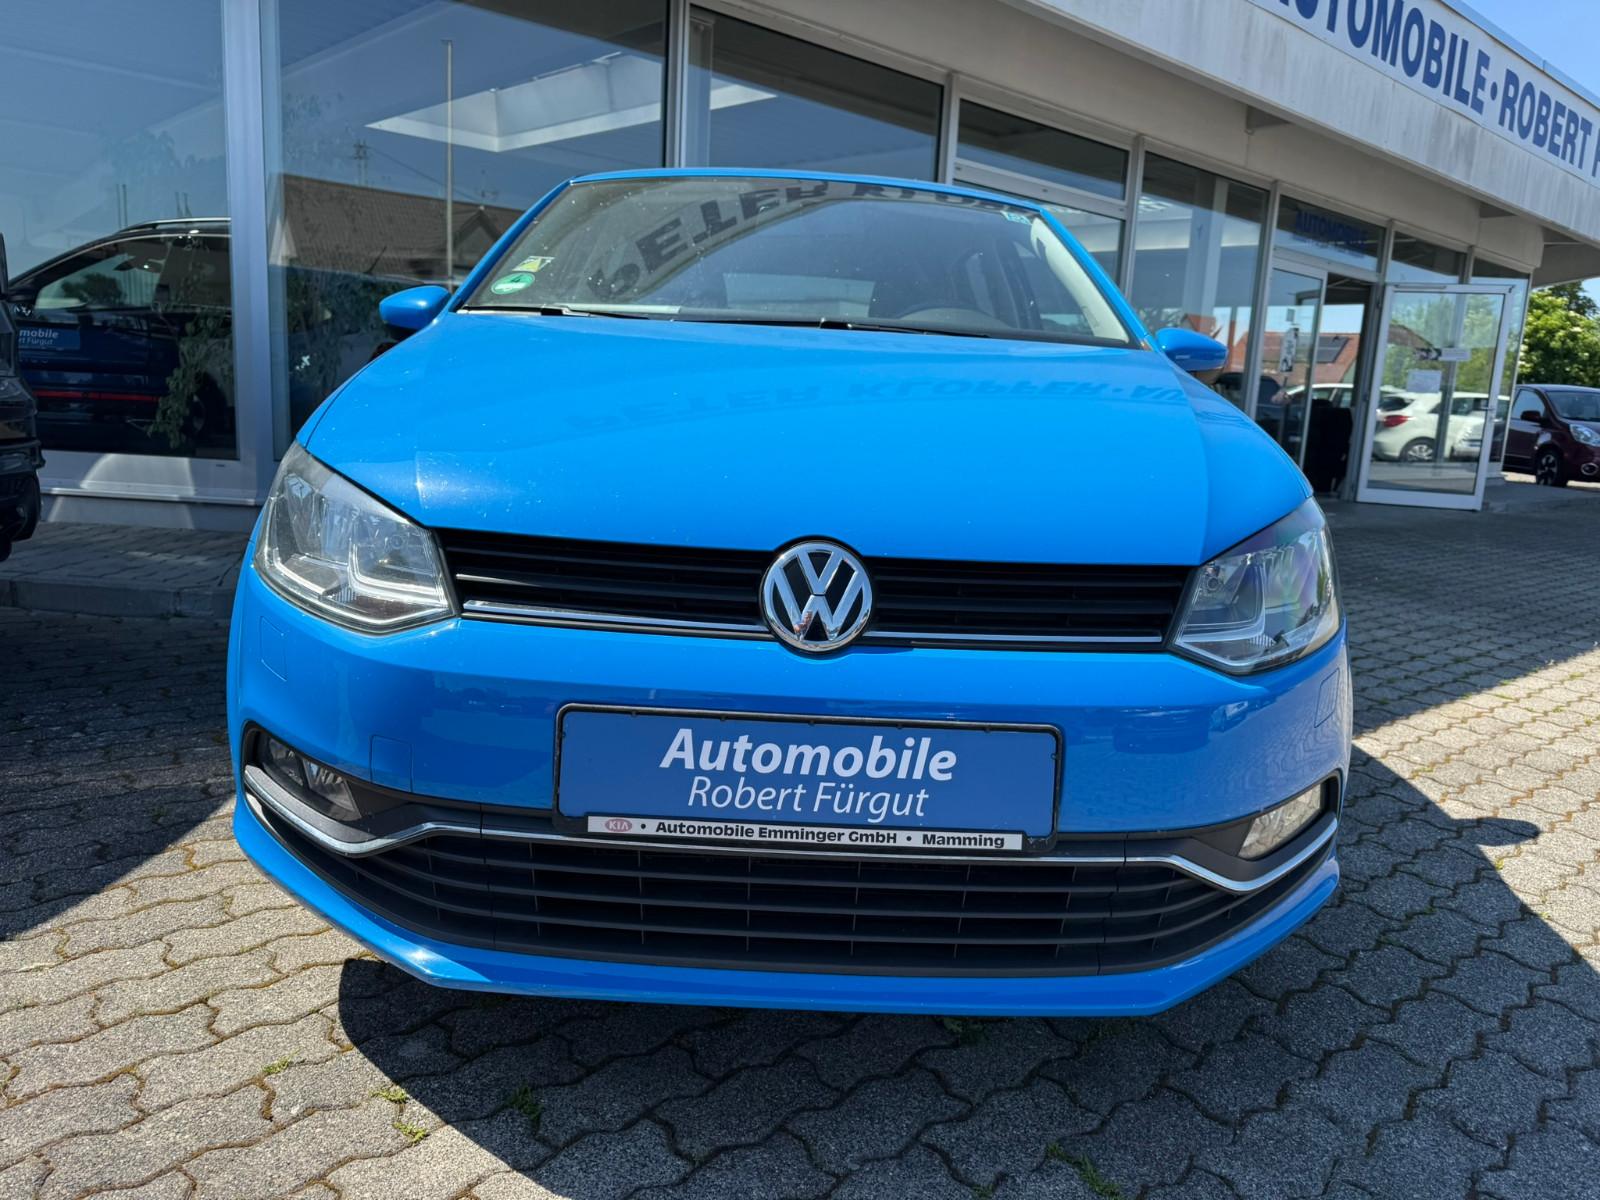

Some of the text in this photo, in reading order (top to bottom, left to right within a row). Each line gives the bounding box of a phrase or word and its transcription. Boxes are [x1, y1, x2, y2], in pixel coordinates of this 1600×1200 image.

[1279, 0, 1491, 115] OMOBILE
[1498, 68, 1593, 170] ROBERT
[765, 543, 872, 649] VW
[660, 728, 957, 781] Automobile
[688, 776, 929, 824] Robert Fürgut
[608, 819, 1005, 848] KIA Automobile Emminger GmbH Mamming
